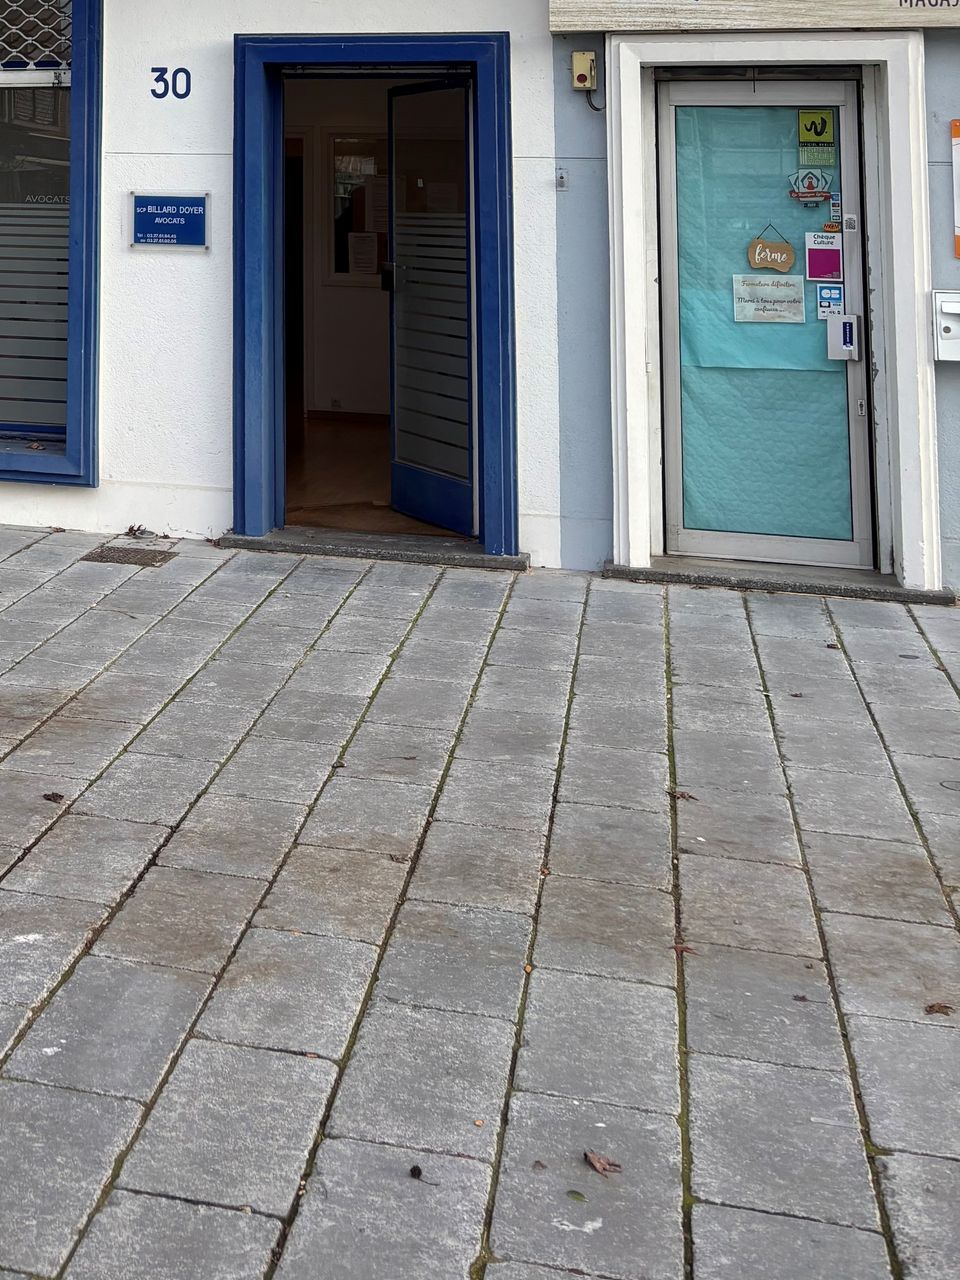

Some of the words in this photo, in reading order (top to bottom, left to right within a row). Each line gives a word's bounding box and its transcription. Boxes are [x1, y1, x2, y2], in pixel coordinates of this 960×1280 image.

[150, 66, 192, 100] 30
[25, 194, 71, 204] AVOCATS
[147, 205, 177, 214] BILLARD
[179, 206, 204, 214] DOYER
[154, 217, 186, 225] AVOCATS
